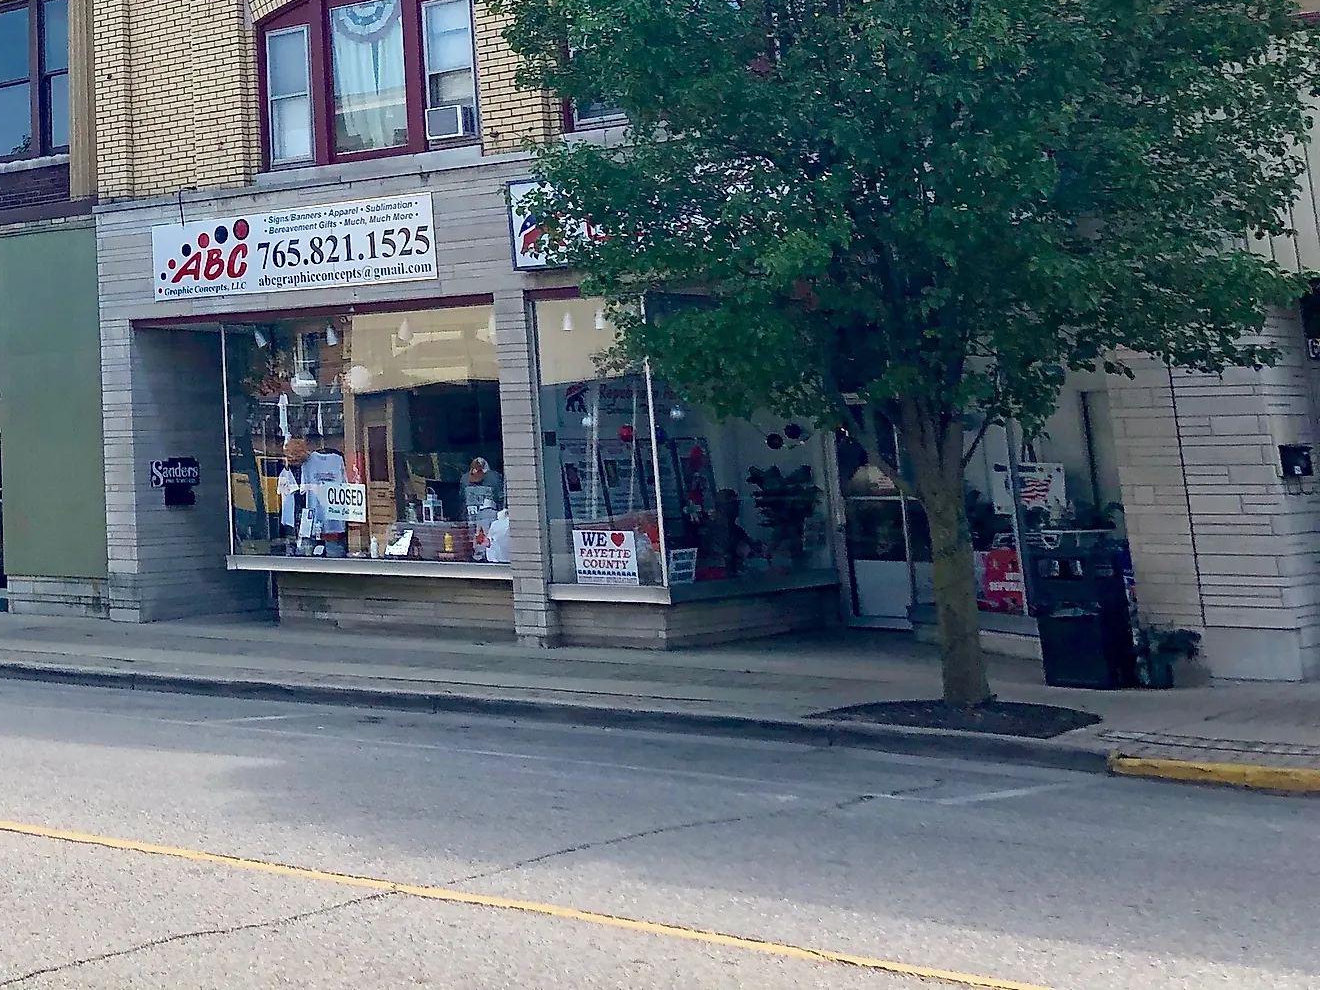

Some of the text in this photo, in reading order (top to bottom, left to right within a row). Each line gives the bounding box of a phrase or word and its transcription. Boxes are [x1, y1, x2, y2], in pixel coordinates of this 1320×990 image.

[268, 200, 413, 225] Signs/Banners Apparel Sublimation
[269, 211, 413, 235] Bereavement Gifts Much, Much More
[257, 225, 431, 269] 765.821.1525
[170, 242, 248, 284] ABC
[258, 261, 432, 289] abcgraphicconcepts@gmail.com
[164, 281, 247, 297] Graphic Concepts, LLC
[151, 459, 199, 487] Sanders
[328, 487, 363, 507] CLOSED
[581, 531, 607, 547] WE
[579, 547, 632, 559] FAYETTE
[582, 559, 629, 569] COUNTY
